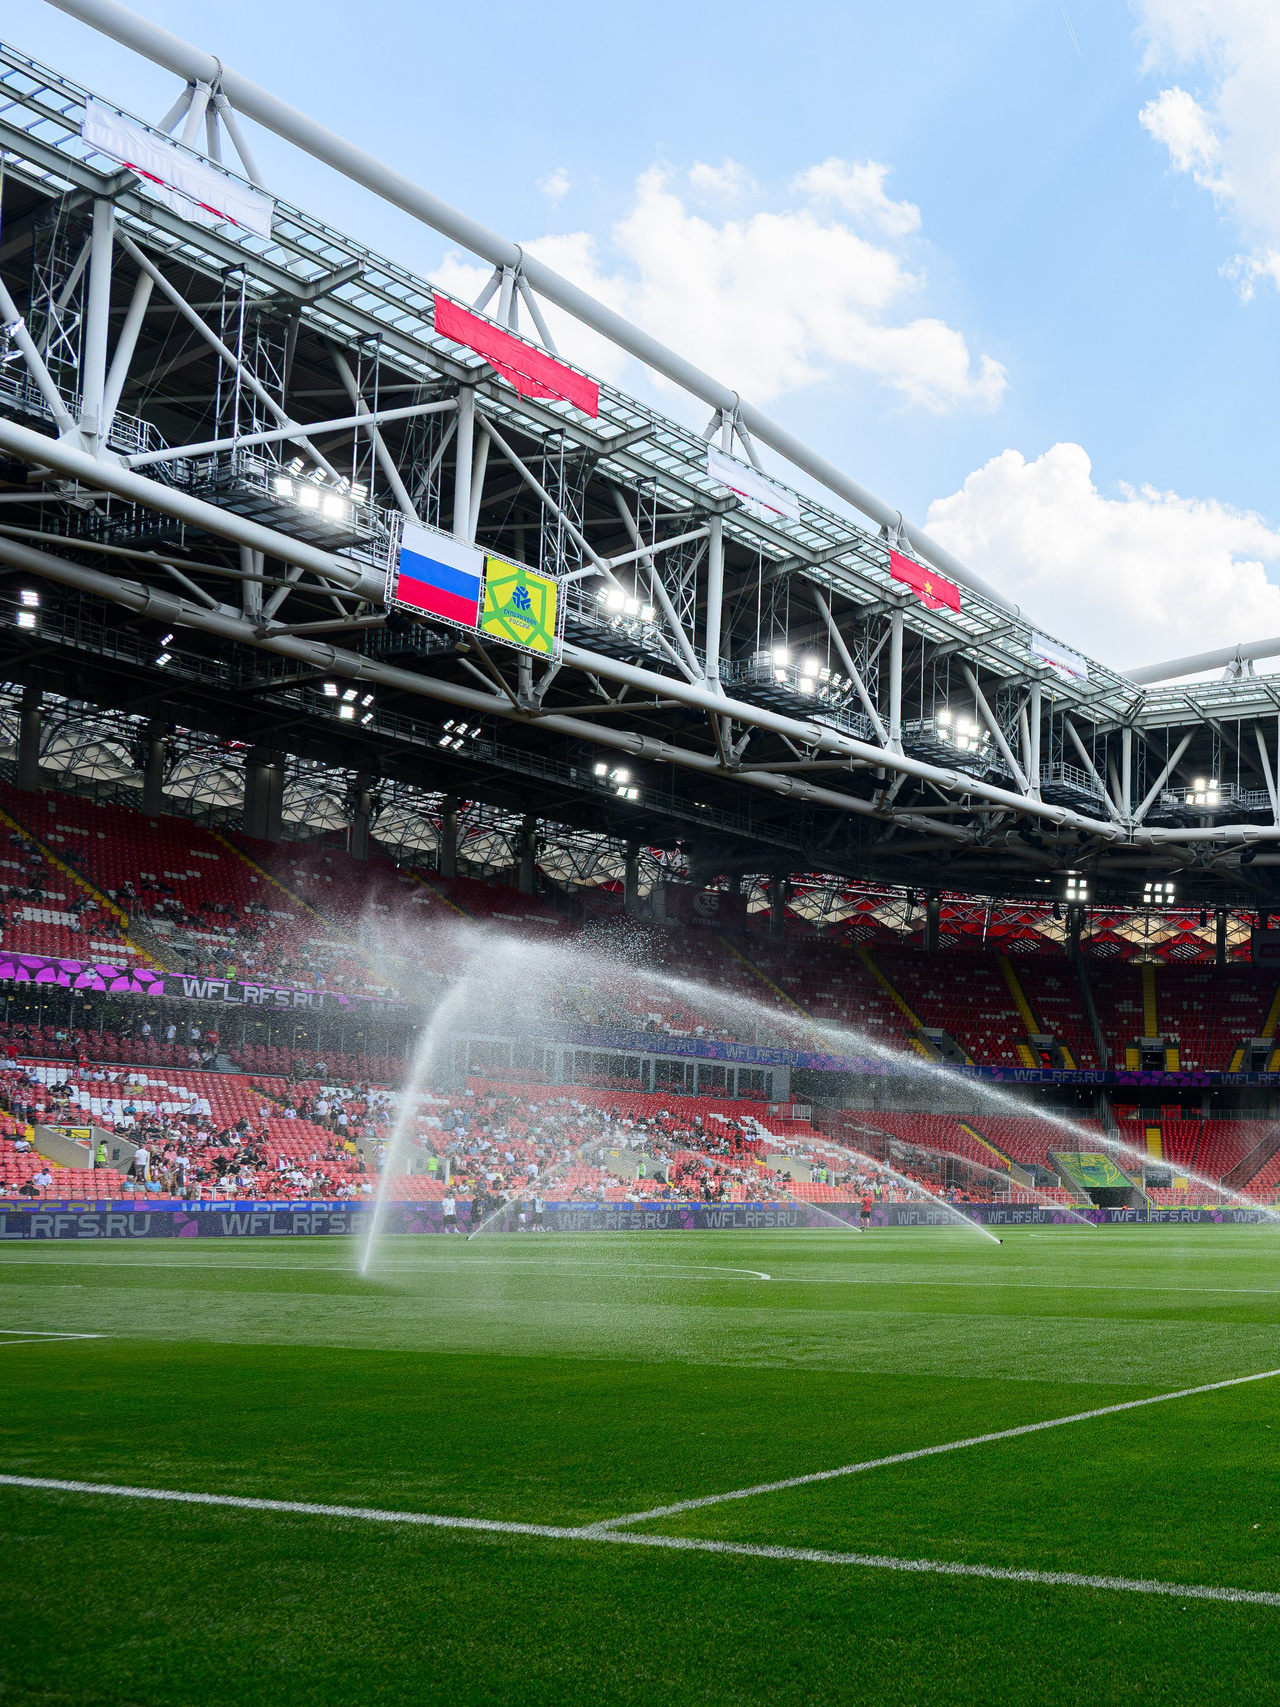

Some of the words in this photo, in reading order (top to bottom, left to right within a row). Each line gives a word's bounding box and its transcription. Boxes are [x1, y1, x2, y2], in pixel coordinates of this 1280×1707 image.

[702, 895, 719, 911] 35
[182, 978, 324, 1010] WFL.RFS.RU
[1014, 1069, 1105, 1083] WFL.RFS.RU
[706, 1211, 797, 1228] WFL.RFS.RU
[988, 1211, 1046, 1224] WFL.RFS.RU
[1110, 1210, 1201, 1222] WFL.RFS.RU
